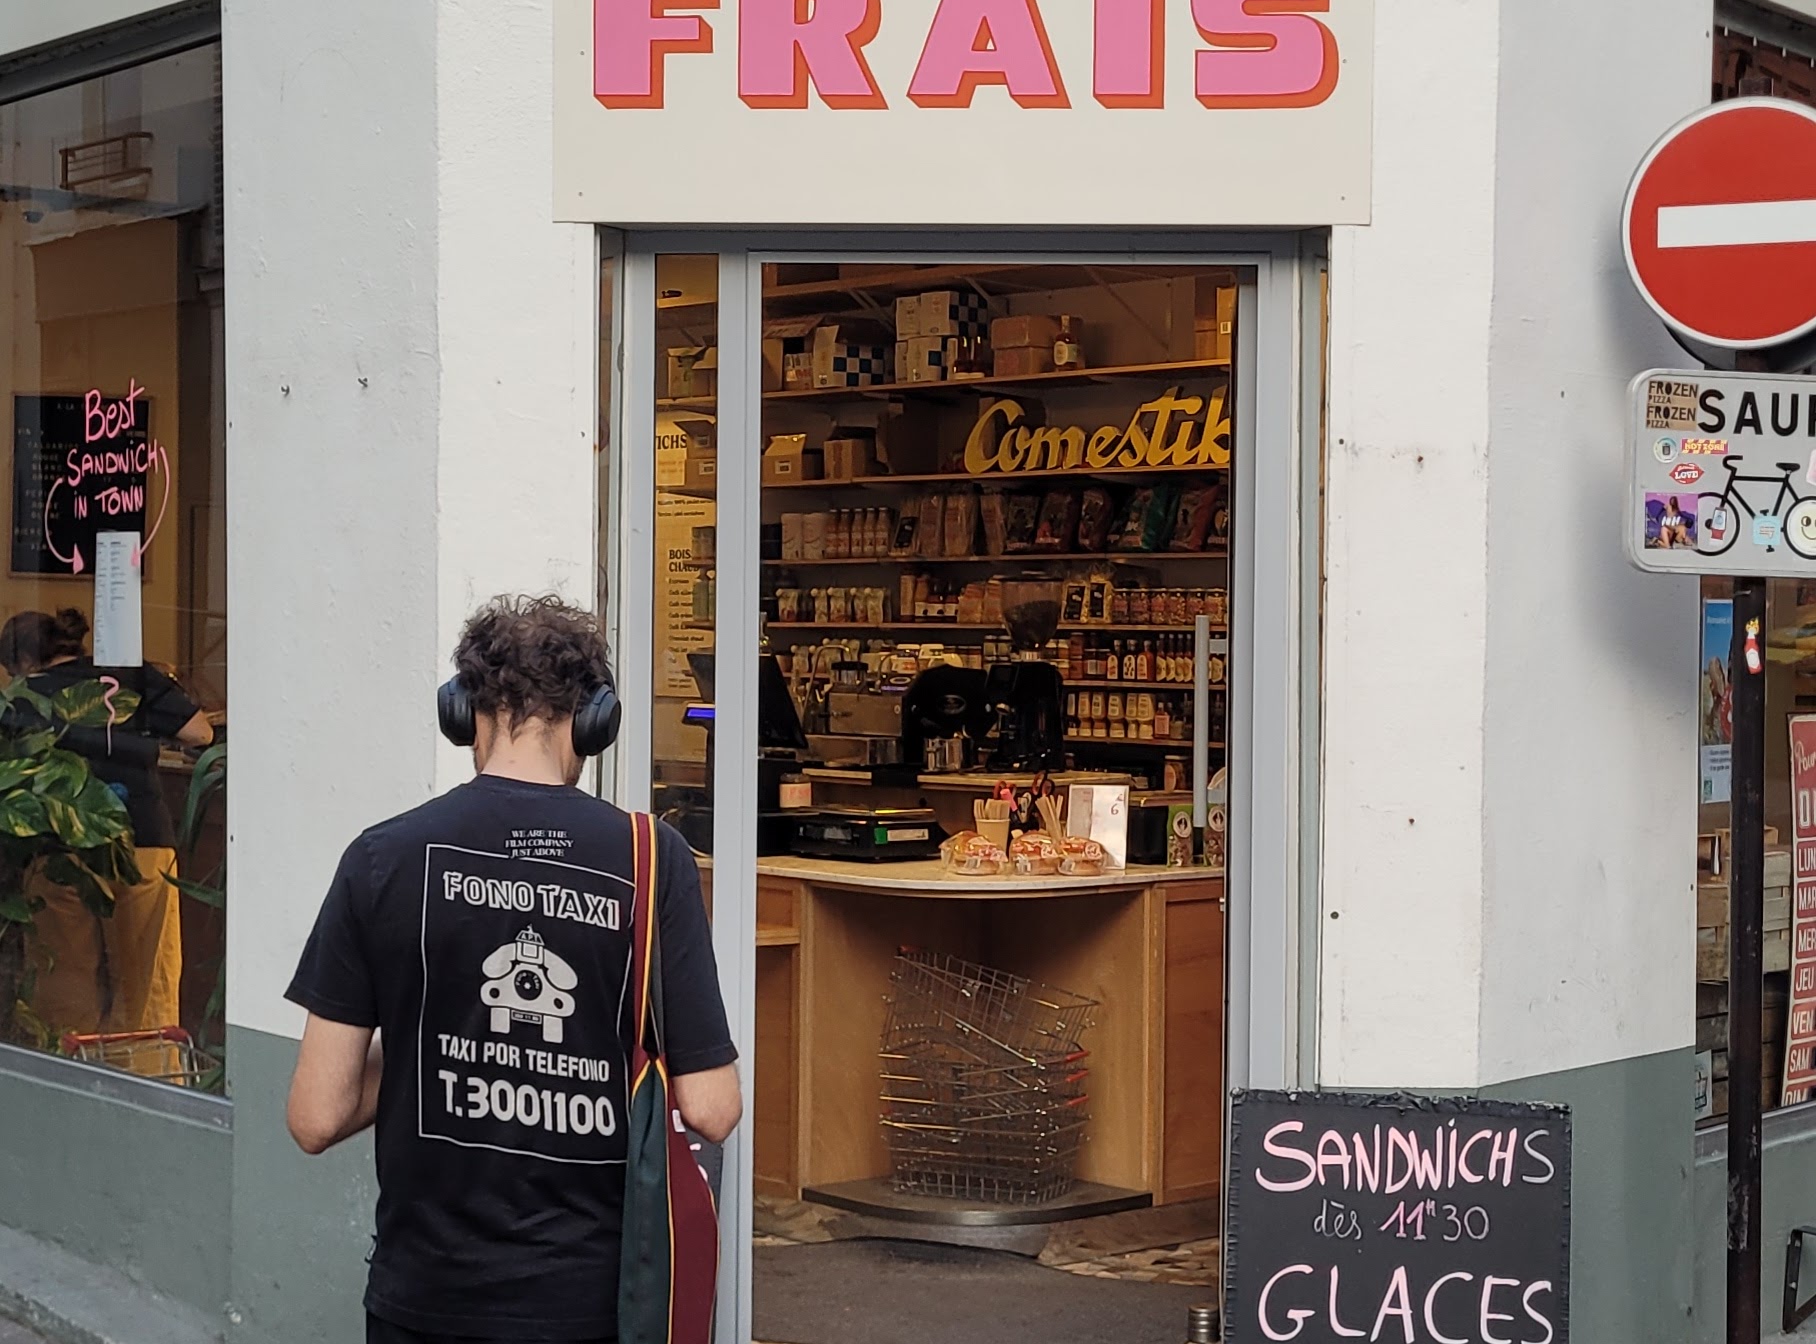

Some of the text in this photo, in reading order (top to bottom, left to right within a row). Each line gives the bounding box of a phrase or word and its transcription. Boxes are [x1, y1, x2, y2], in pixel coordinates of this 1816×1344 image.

[1648, 395, 1671, 404] PIZZA
[1649, 381, 1698, 397] FROZEN
[85, 378, 145, 443] Best
[1647, 406, 1697, 422] FROZEN
[1646, 419, 1670, 429] PIZZA
[94, 485, 143, 515] TOWN
[505, 839, 574, 848] FILM COMPANY
[511, 830, 567, 838] WE ARE THE
[510, 848, 565, 859] JUST ABOVE
[1796, 965, 1814, 991] JEU
[1793, 1010, 1814, 1035] VEN
[438, 1034, 610, 1083] TAXI POR TELEFONO
[1790, 1047, 1810, 1073] SAM
[438, 1070, 616, 1137] T.3001100
[1313, 1199, 1362, 1240] dès
